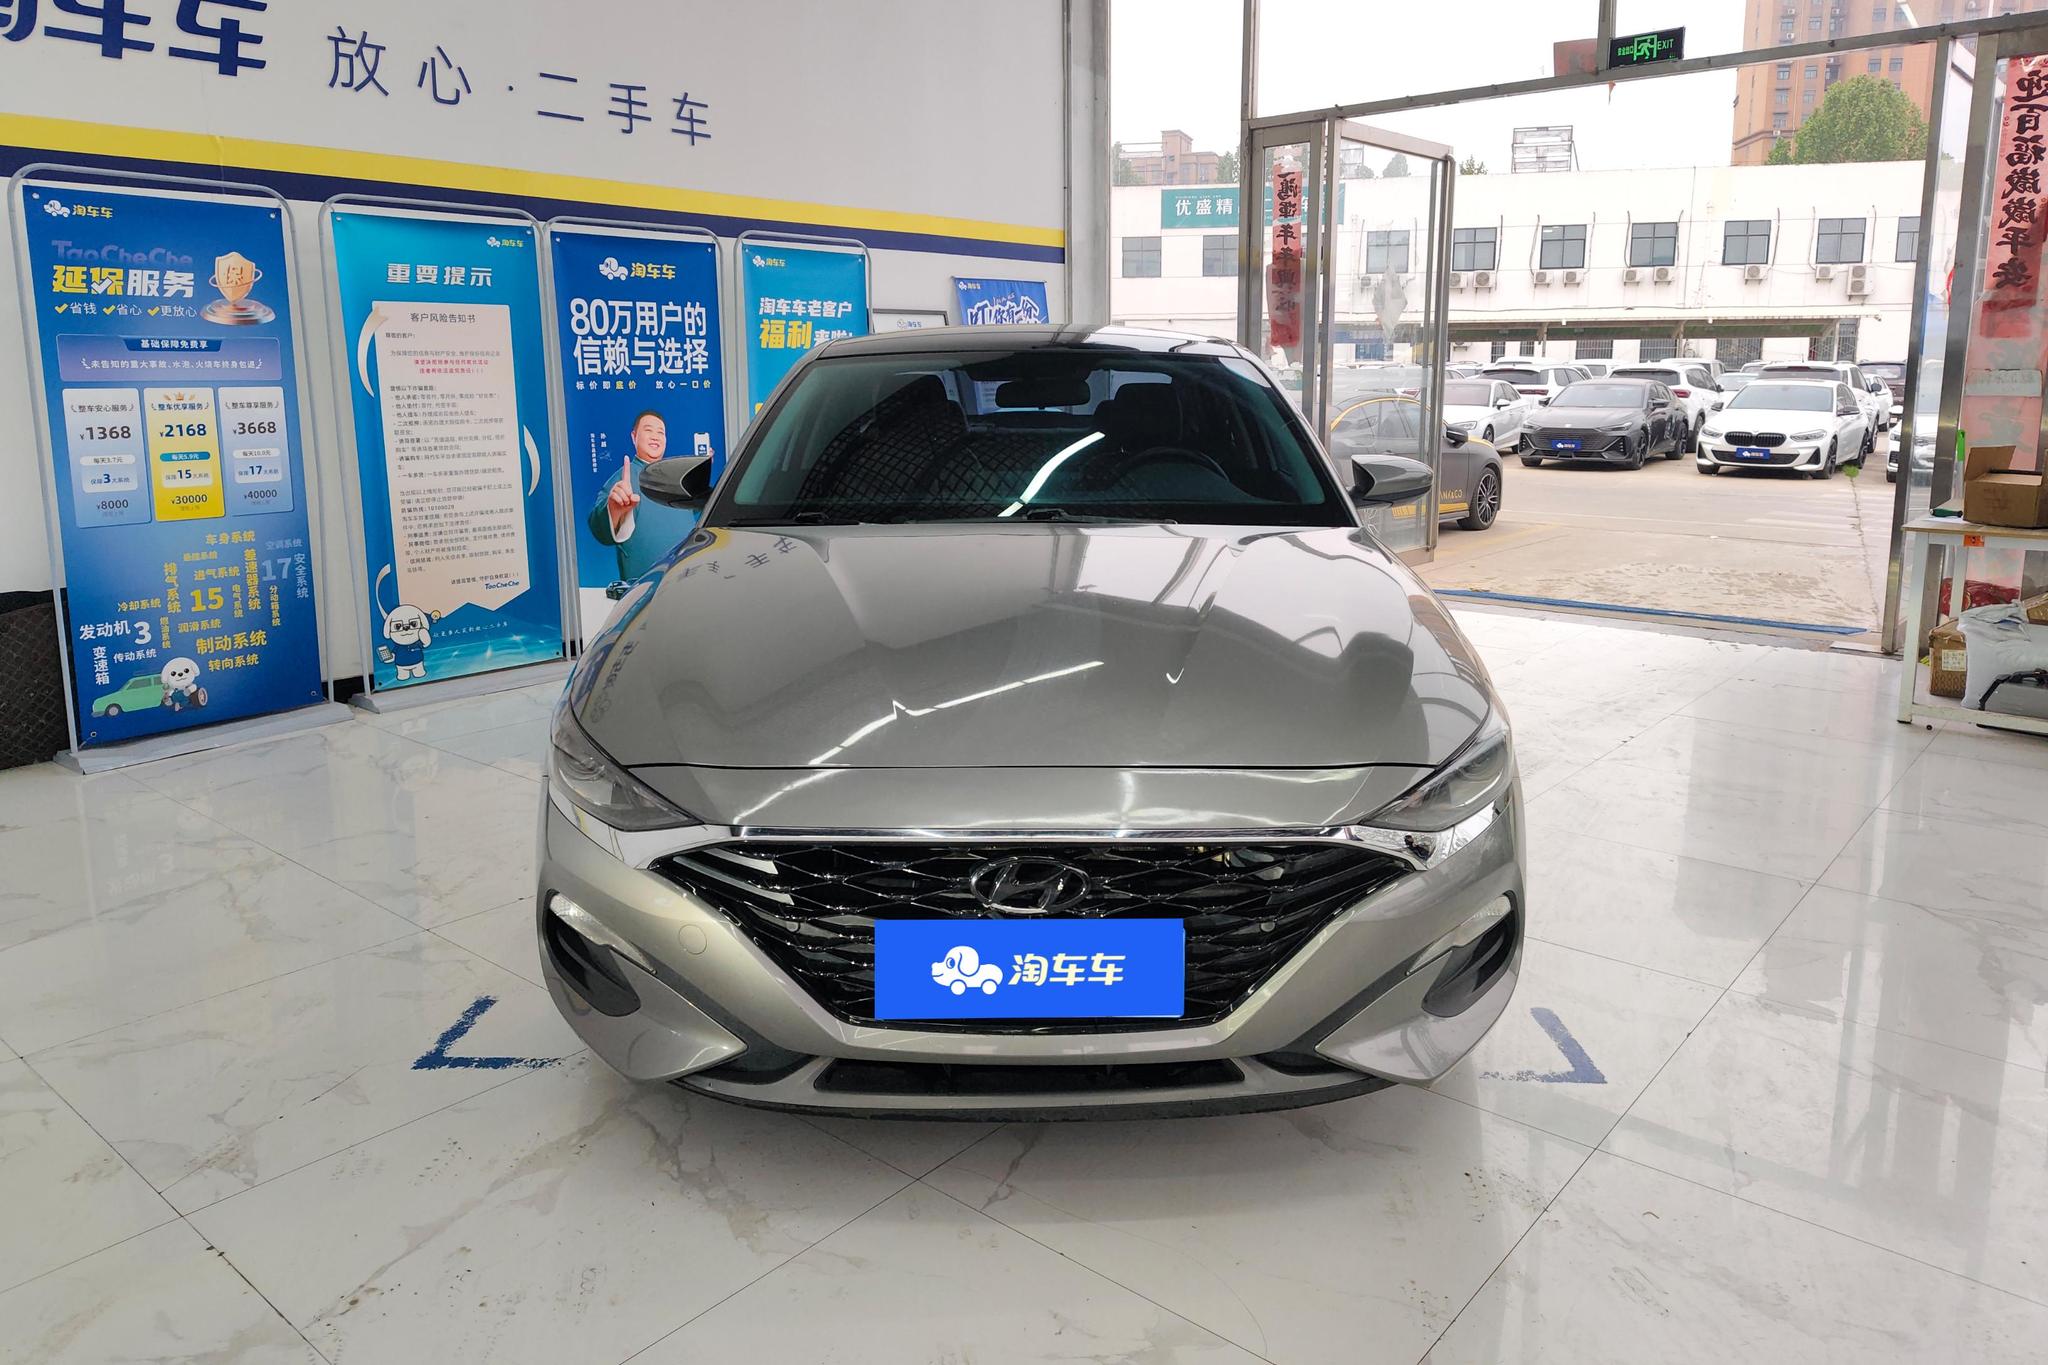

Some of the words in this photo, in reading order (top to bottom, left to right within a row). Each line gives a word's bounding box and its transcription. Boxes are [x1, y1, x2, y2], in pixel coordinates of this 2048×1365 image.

[0, 0, 268, 76] 车车
[1657, 38, 1674, 50] EXIT
[72, 204, 113, 219] 淘车车
[501, 238, 525, 248] 淘车车
[52, 240, 193, 264] TaoCheChe
[386, 262, 493, 287] 重要提示
[630, 262, 677, 280] 淘车车
[52, 265, 195, 298] 延保服务
[70, 302, 97, 315] 省钱
[116, 304, 142, 316] 省心
[160, 305, 198, 318] 更放心
[759, 297, 852, 318] 淘车车老客户
[410, 312, 476, 324] 客户风险告知书
[570, 297, 707, 337] 80万用户的
[140, 339, 208, 349] 基础保障免费享
[573, 335, 709, 376] 信赖与选择
[575, 381, 637, 390] 标价即底价
[655, 380, 711, 389] 放心一口价
[78, 403, 128, 413] 整车安心服务
[157, 402, 204, 412] 整车优享服务
[231, 400, 275, 410] 整车尊享服务
[79, 426, 132, 442] ¥1368
[159, 423, 207, 438] ¥2168
[232, 421, 277, 436] ¥3668
[171, 494, 208, 505] ¥30000
[243, 489, 278, 500] ¥40000
[96, 499, 130, 511] ¥8000
[206, 530, 256, 546] 车身系统
[265, 538, 303, 551] 空调系统
[193, 565, 241, 582] 进气系统
[261, 557, 293, 582] 17
[293, 552, 310, 599] 安全系统
[163, 561, 182, 615] 排气系统
[243, 548, 262, 611] 差速器系统
[485, 581, 520, 590] TaoCheChe
[117, 598, 162, 613] 冷却系统
[189, 587, 225, 613] 15
[231, 583, 244, 619] 电气系统
[269, 584, 282, 627] 分动箱系统
[79, 619, 132, 641] 发动机
[133, 621, 152, 645] 3
[177, 618, 223, 634] 润滑系统
[195, 629, 268, 656] 制动系统
[113, 647, 158, 664] 传动系统
[207, 653, 260, 673] 转向系统
[92, 645, 111, 686] 变速箱
